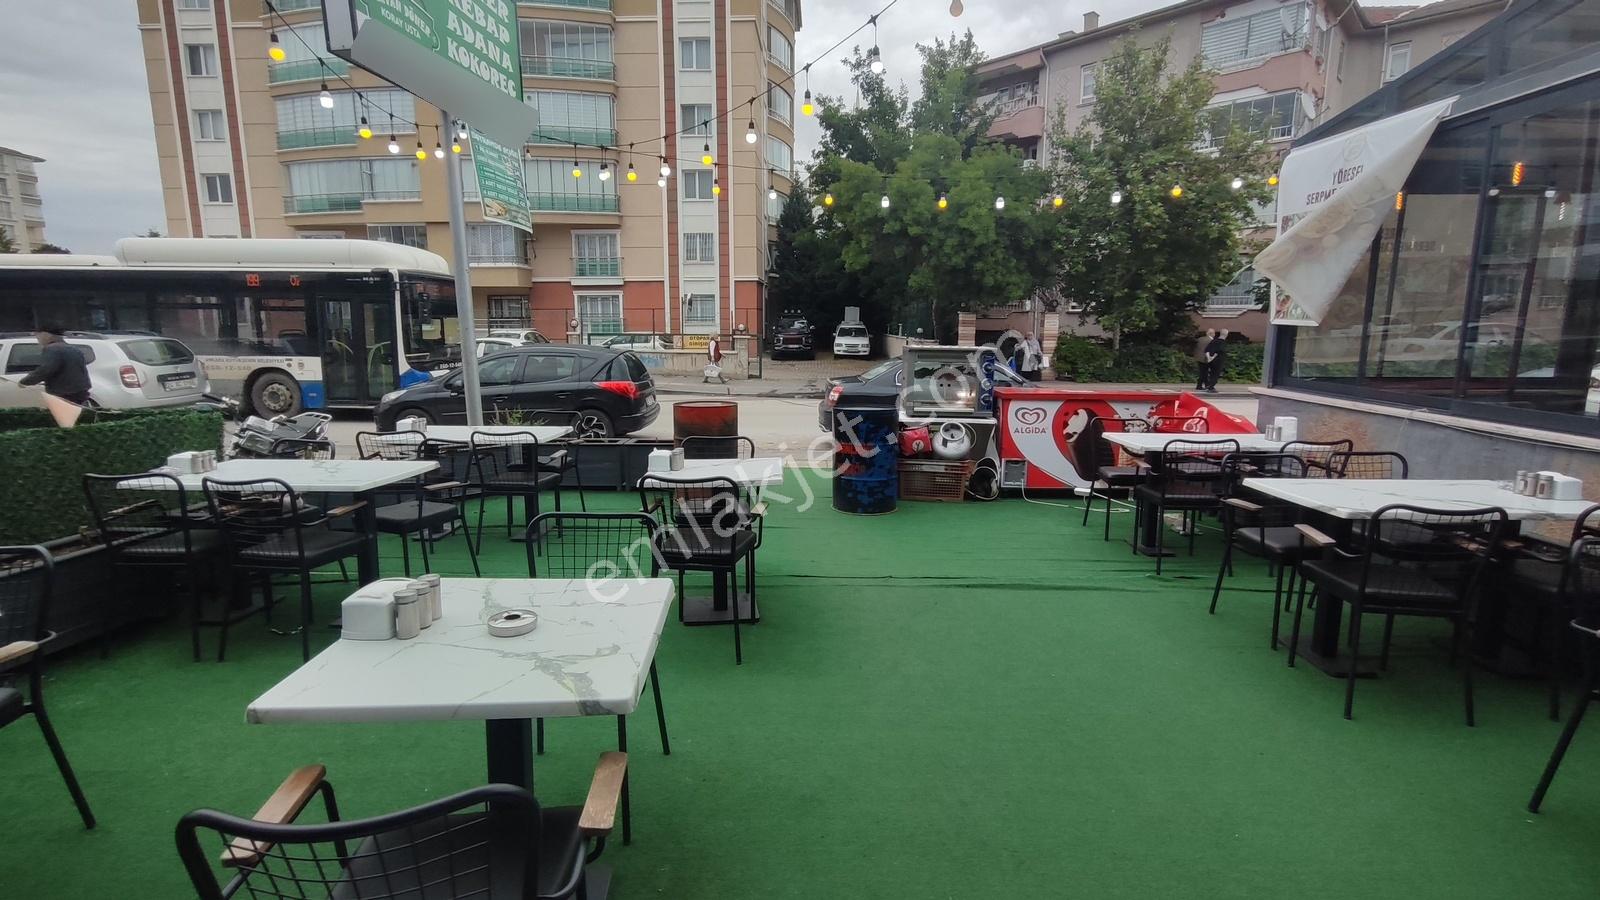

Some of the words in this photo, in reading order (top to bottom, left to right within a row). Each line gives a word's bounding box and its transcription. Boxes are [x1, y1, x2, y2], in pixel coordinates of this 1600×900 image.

[405, 22, 422, 40] USTA
[446, 10, 514, 73] ADANA
[448, 0, 511, 45] EBAP
